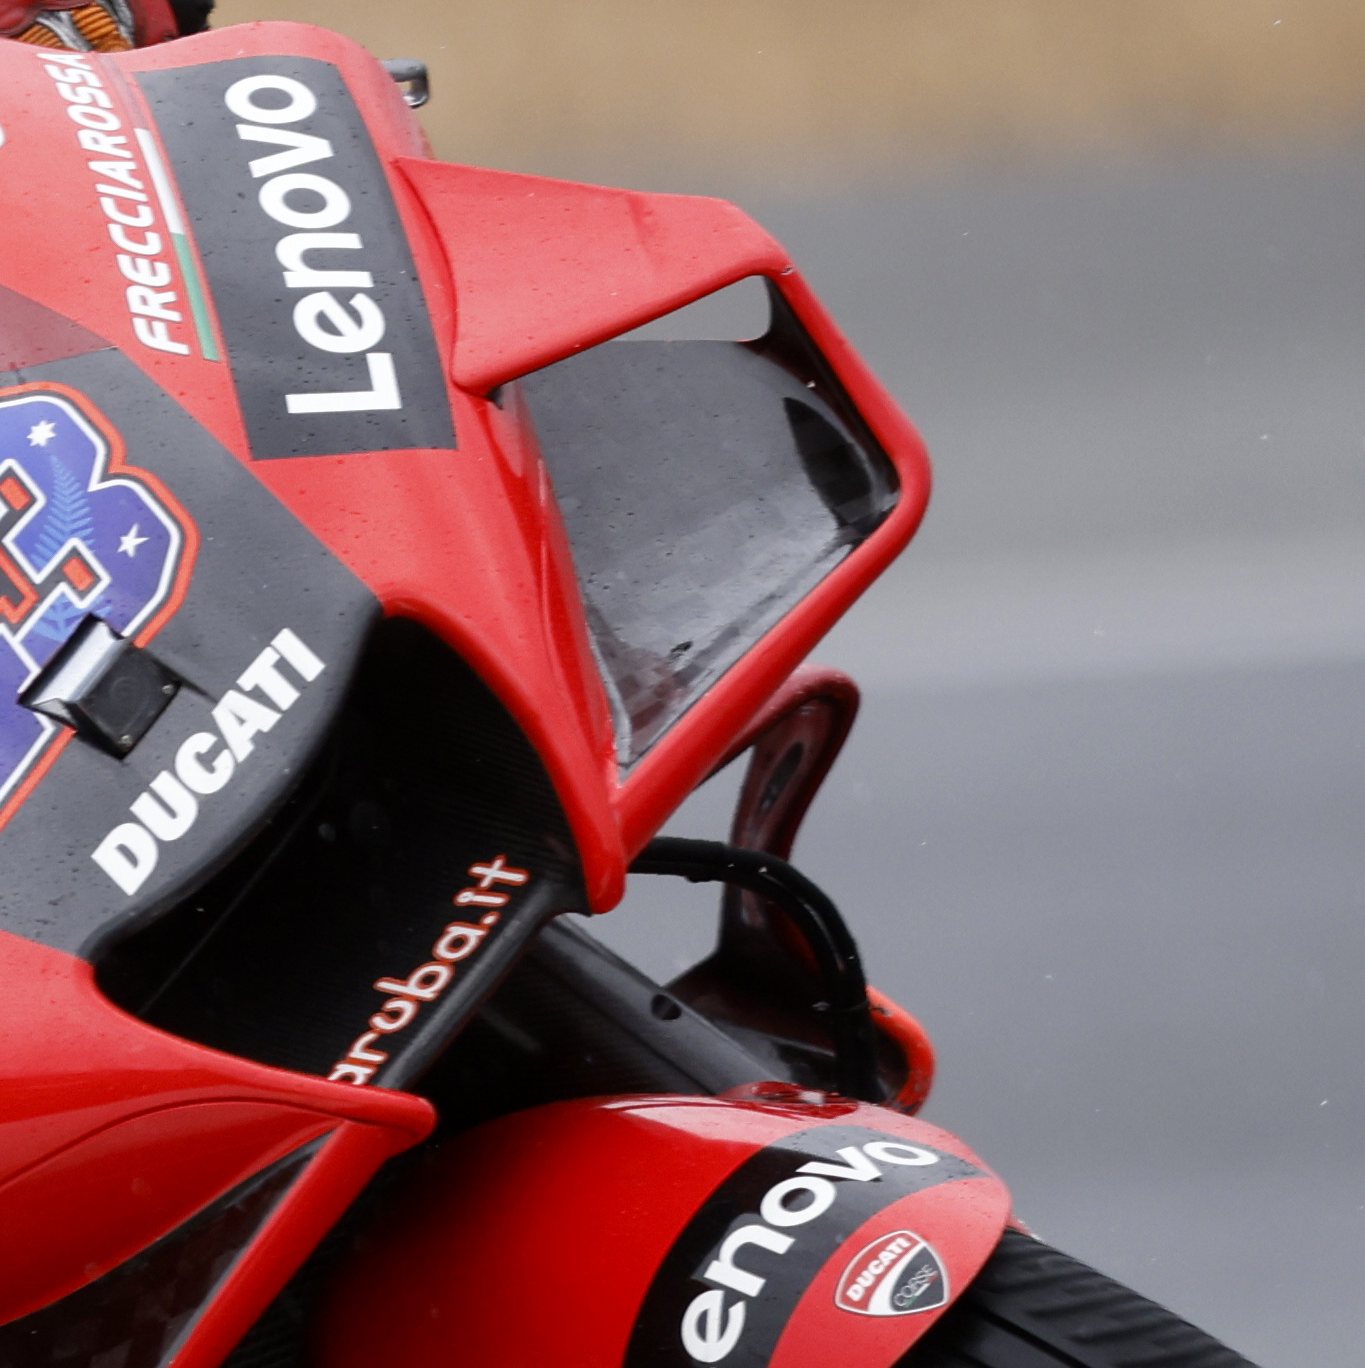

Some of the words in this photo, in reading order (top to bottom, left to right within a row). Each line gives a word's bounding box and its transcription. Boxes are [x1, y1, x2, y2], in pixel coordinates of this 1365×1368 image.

[36, 52, 191, 357] FRECCIAROSSA
[222, 73, 404, 416] Lenovo
[90, 626, 326, 896] DUCATI
[325, 855, 530, 1088] aruba.it
[845, 1237, 912, 1303] DUCATI
